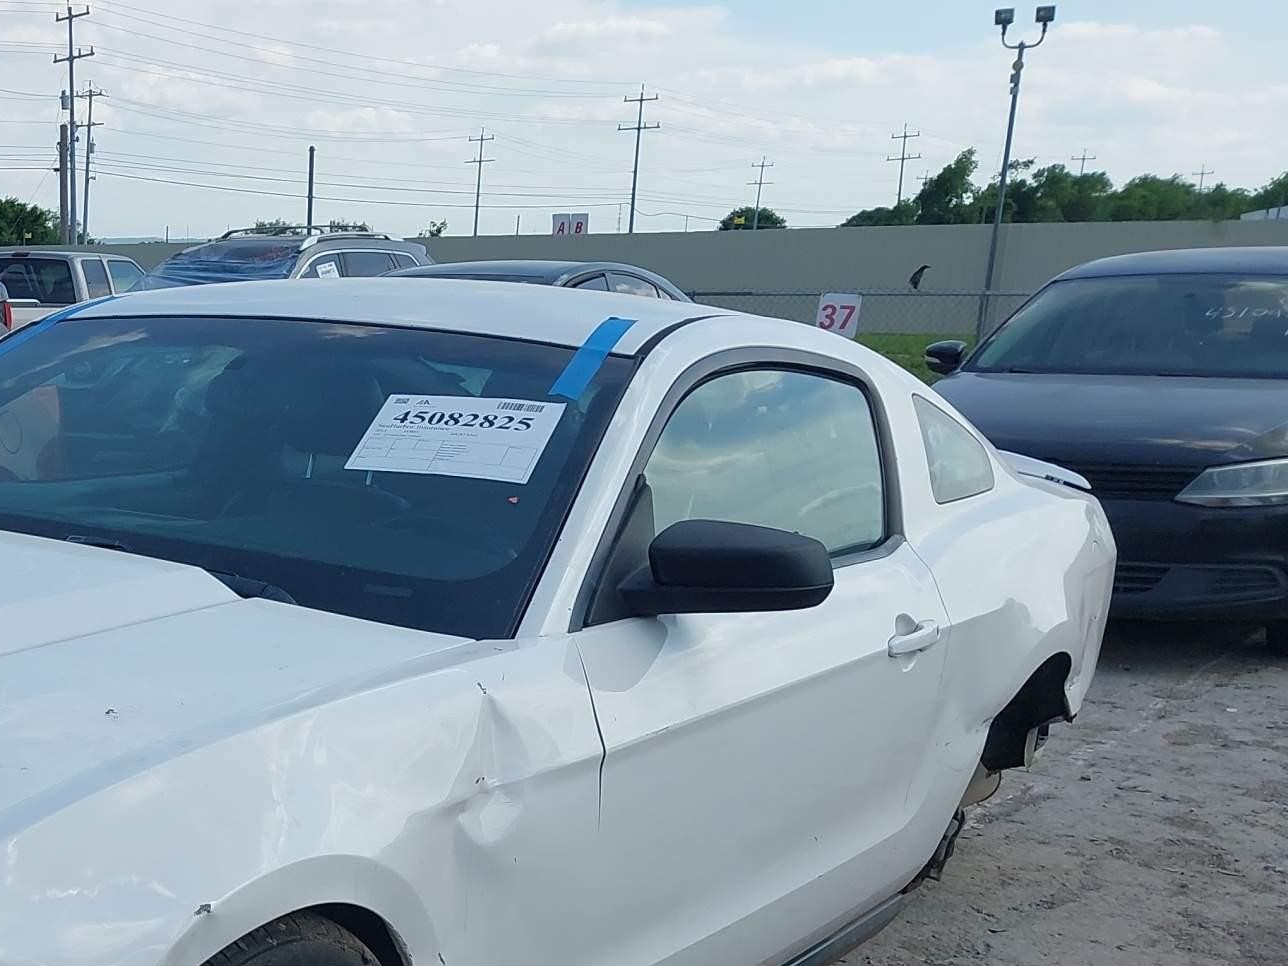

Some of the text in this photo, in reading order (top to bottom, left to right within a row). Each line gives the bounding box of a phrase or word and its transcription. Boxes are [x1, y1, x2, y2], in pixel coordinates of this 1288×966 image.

[556, 221, 565, 234] A
[574, 221, 583, 234] B
[819, 304, 856, 330] 37
[392, 410, 536, 431] 45082825
